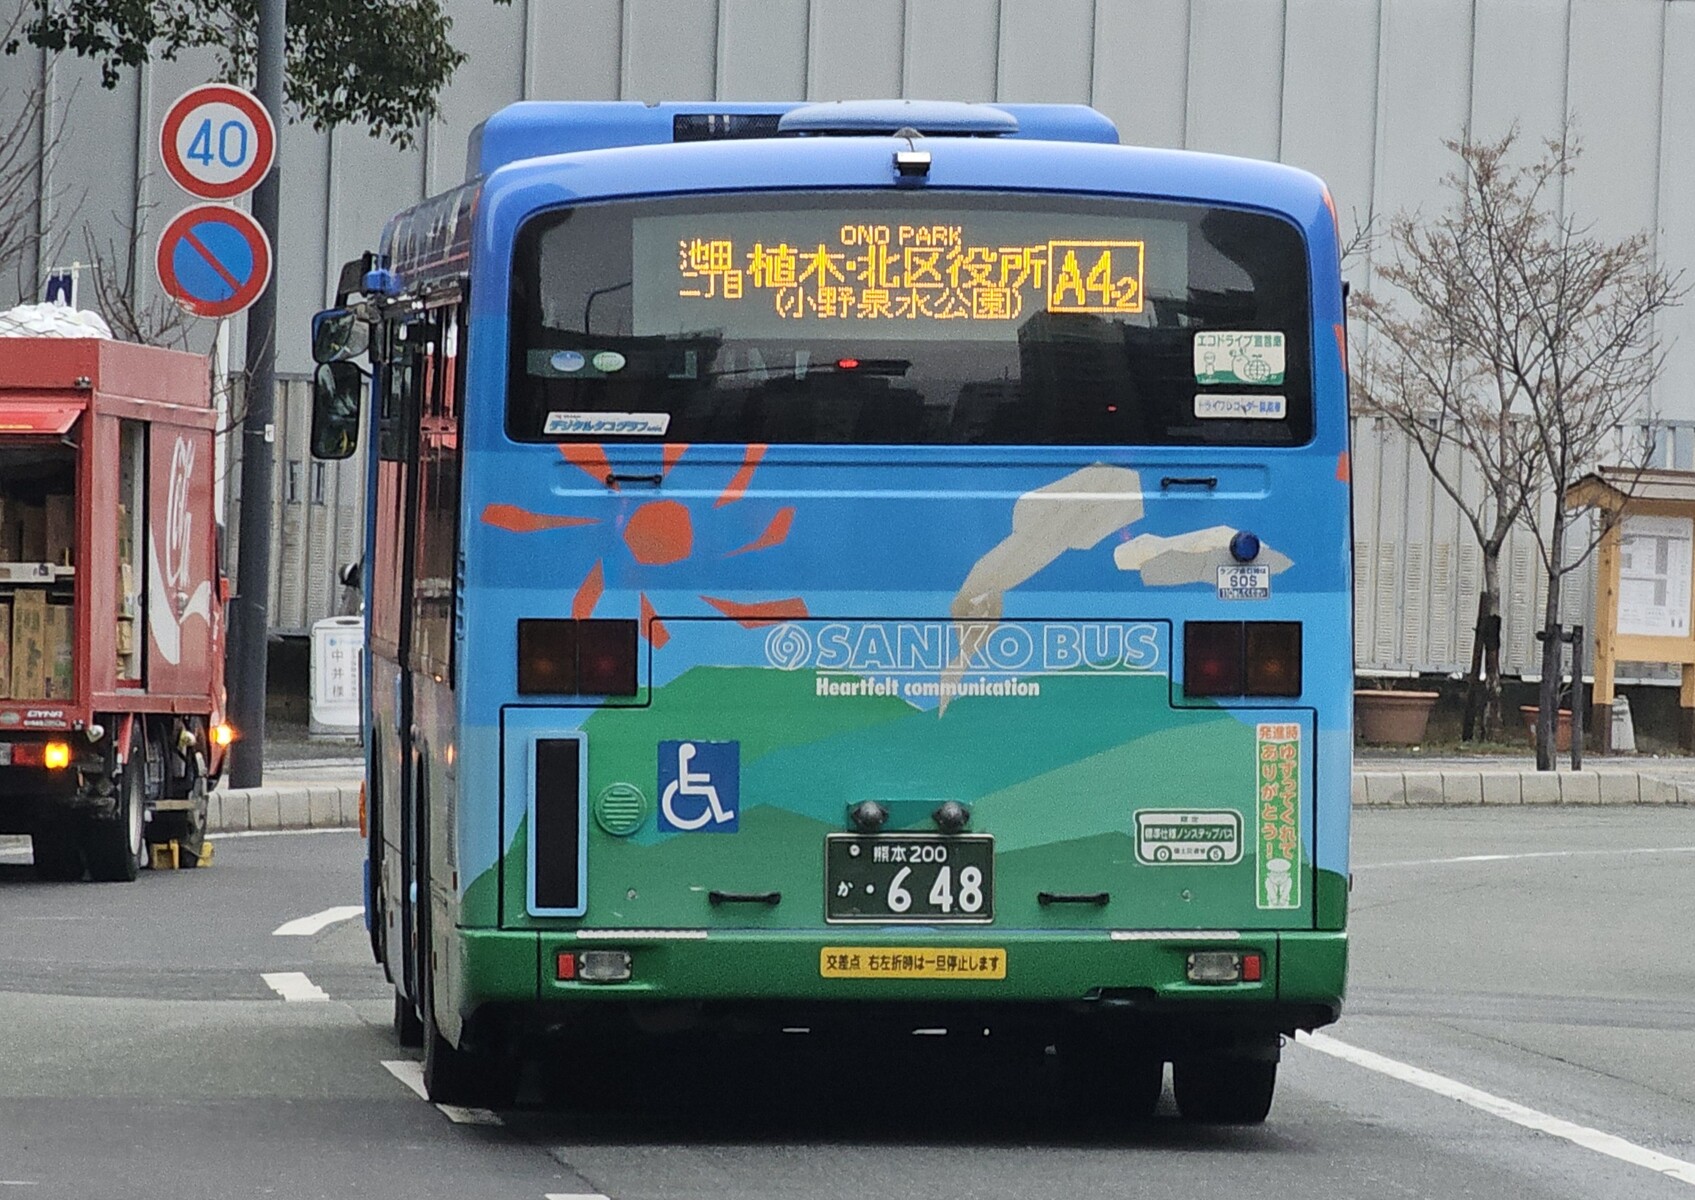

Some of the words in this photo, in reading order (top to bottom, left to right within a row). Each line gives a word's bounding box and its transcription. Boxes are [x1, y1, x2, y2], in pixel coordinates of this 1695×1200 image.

[187, 118, 248, 168] 40
[841, 225, 889, 245] ONO
[899, 226, 963, 245] PARK
[1230, 575, 1257, 587] SOS
[815, 624, 1033, 669] SANKO
[1044, 624, 1160, 669] BUS
[816, 677, 898, 696] Heartfelt
[904, 677, 1040, 696] communication
[1279, 744, 1297, 860] ゆずってくれて
[909, 846, 947, 863] 200
[826, 954, 861, 970] 交差点
[868, 954, 999, 971] 右左折時は一旦停止します
